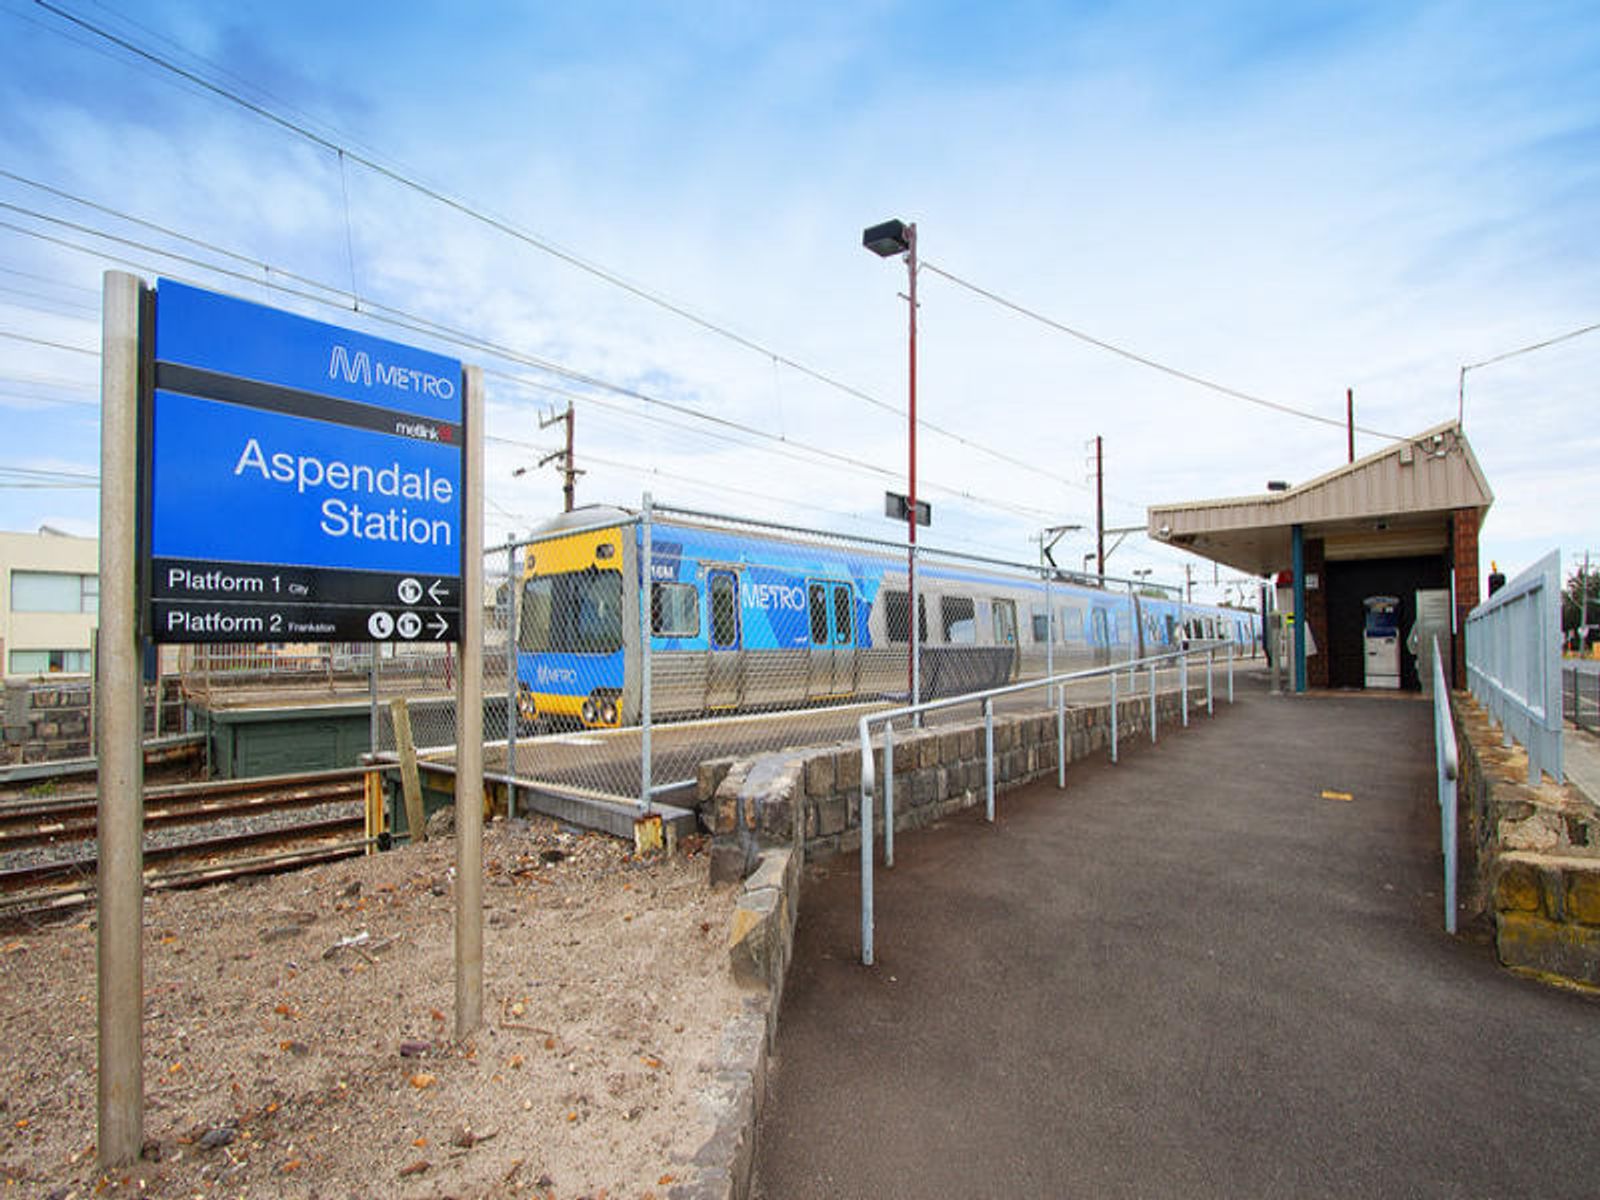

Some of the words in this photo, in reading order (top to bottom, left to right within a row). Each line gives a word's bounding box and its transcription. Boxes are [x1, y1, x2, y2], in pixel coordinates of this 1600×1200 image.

[375, 363, 454, 399] METRO
[234, 438, 454, 504] Aspendale
[320, 499, 452, 546] Station
[167, 568, 264, 593] Platform
[271, 575, 281, 594] 1
[288, 582, 310, 596] City
[741, 582, 806, 611] METRO
[166, 611, 264, 633] Platform
[269, 614, 282, 633] 2
